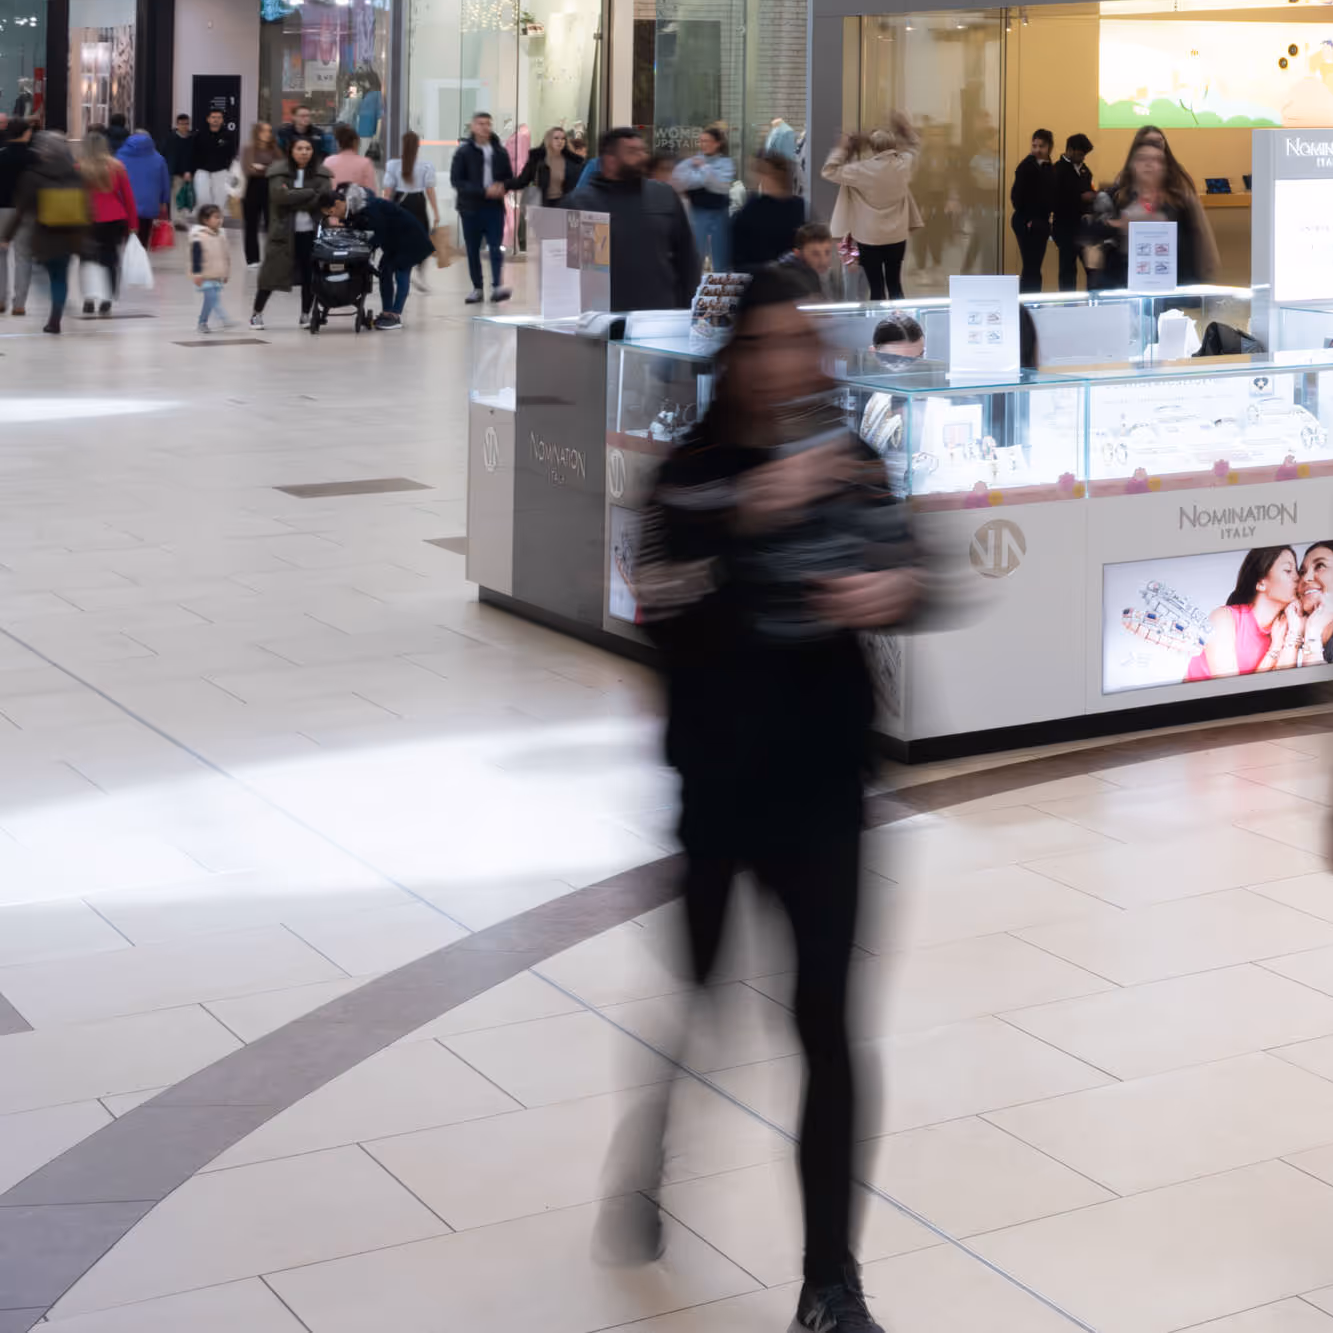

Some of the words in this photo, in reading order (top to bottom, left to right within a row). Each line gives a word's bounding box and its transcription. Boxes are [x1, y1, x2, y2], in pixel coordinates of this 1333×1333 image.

[656, 127, 703, 139] WOME
[655, 139, 702, 148] UPSTAIR
[1179, 501, 1298, 530] NOMINATION
[1220, 526, 1257, 539] ITALY
